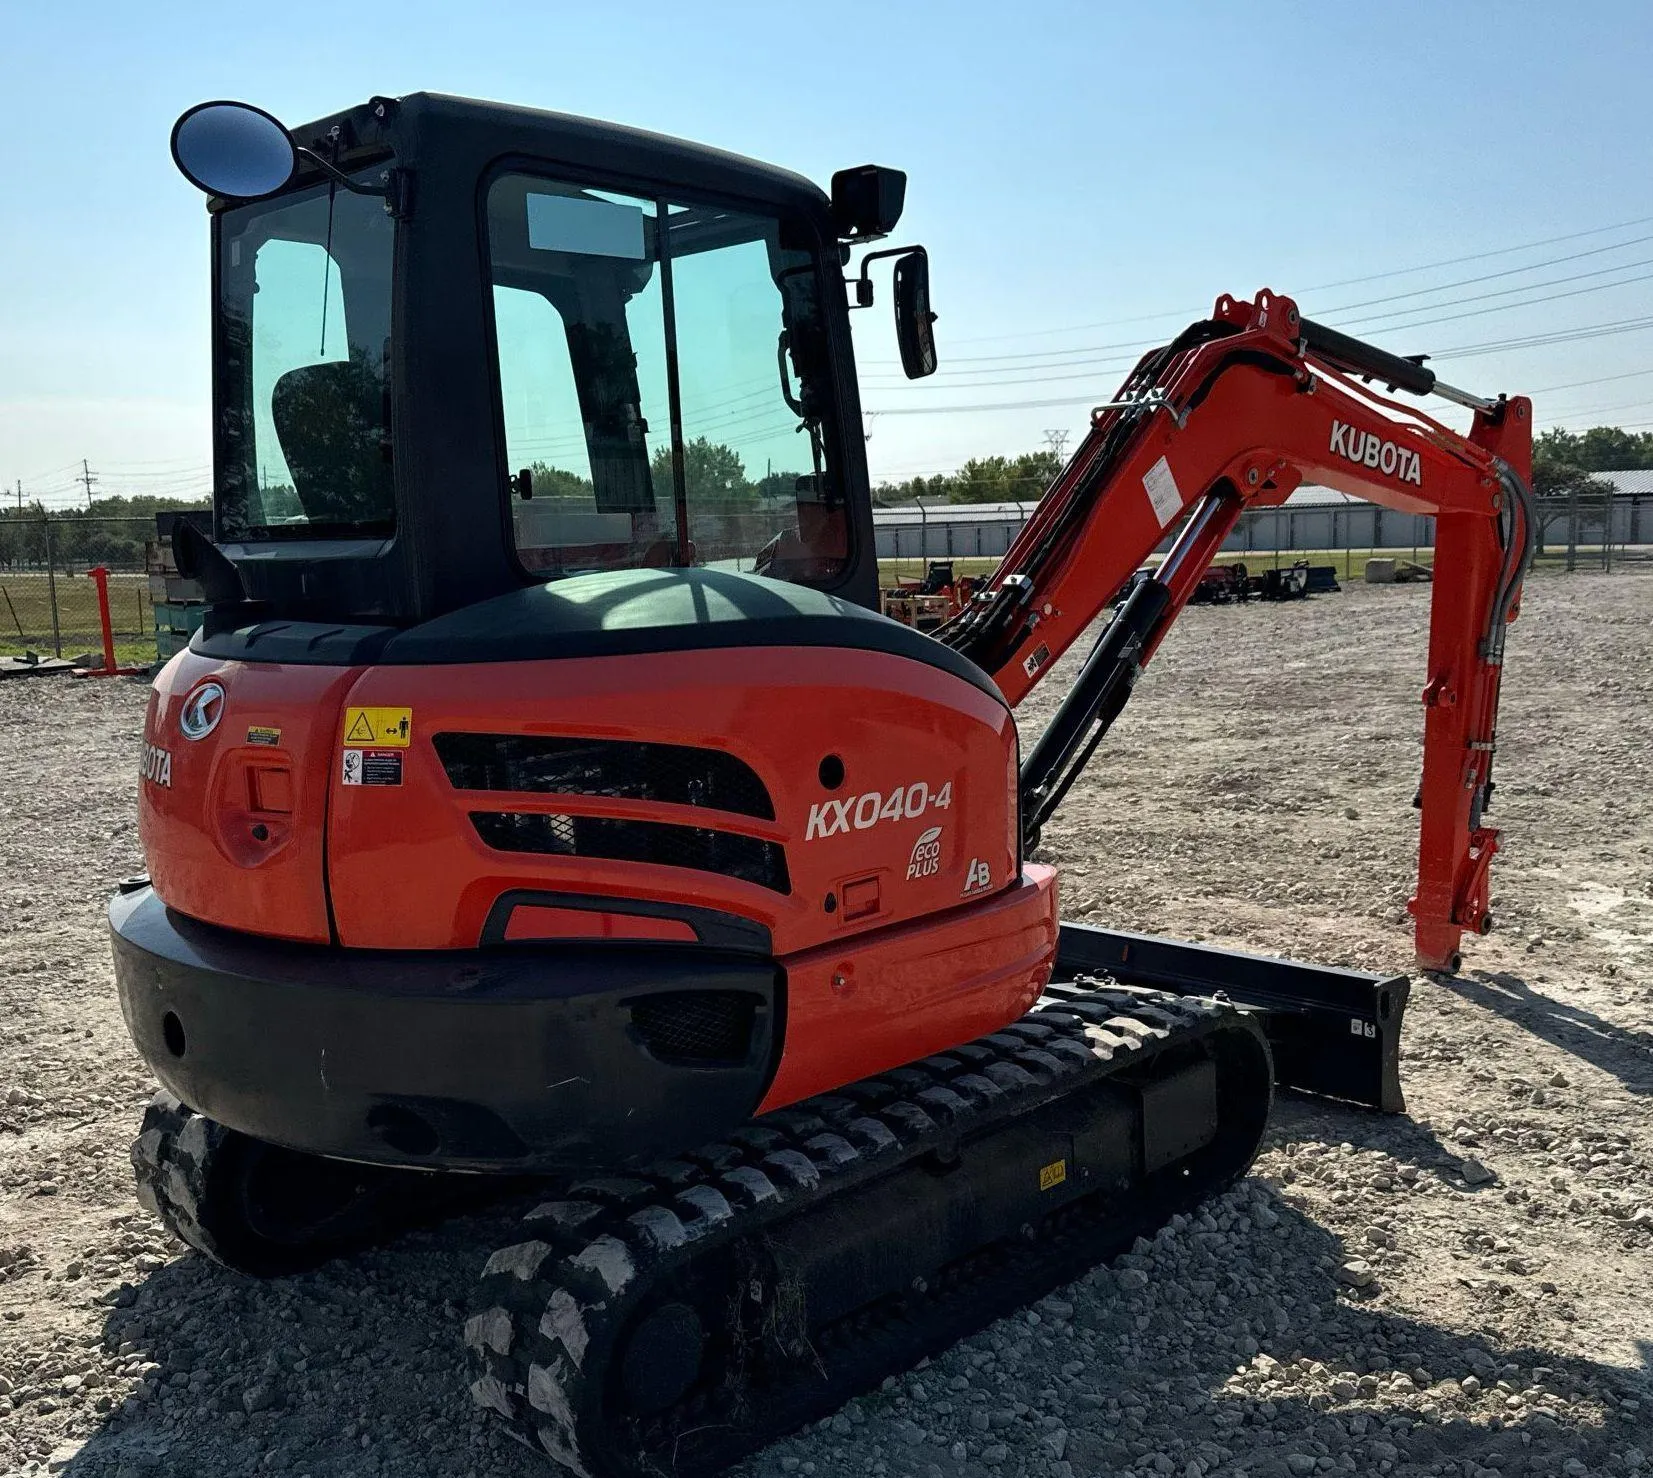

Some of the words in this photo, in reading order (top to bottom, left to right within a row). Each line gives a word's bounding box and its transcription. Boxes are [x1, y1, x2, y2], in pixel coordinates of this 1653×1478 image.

[1329, 419, 1421, 486] KUBOTA
[140, 742, 171, 788] BOTA
[805, 781, 952, 841] KX040-4
[906, 858, 939, 881] PLUS
[916, 841, 940, 861] eco
[963, 857, 991, 891] AB
